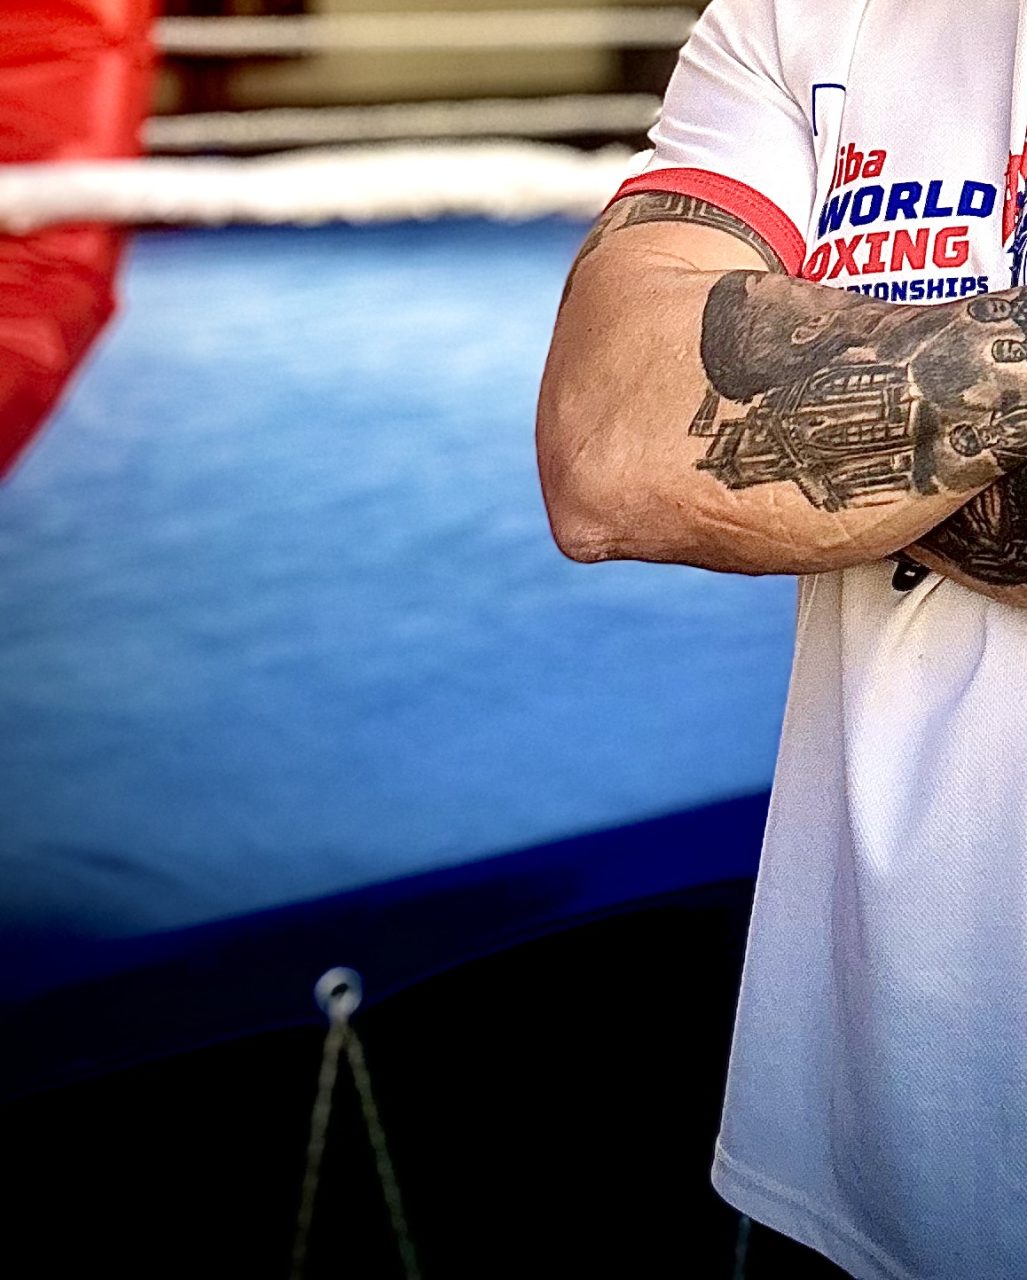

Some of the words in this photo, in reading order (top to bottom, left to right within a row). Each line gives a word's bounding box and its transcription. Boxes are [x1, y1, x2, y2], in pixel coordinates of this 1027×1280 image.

[832, 143, 887, 189] iba
[817, 180, 997, 239] WORLD
[802, 226, 969, 282] OXING
